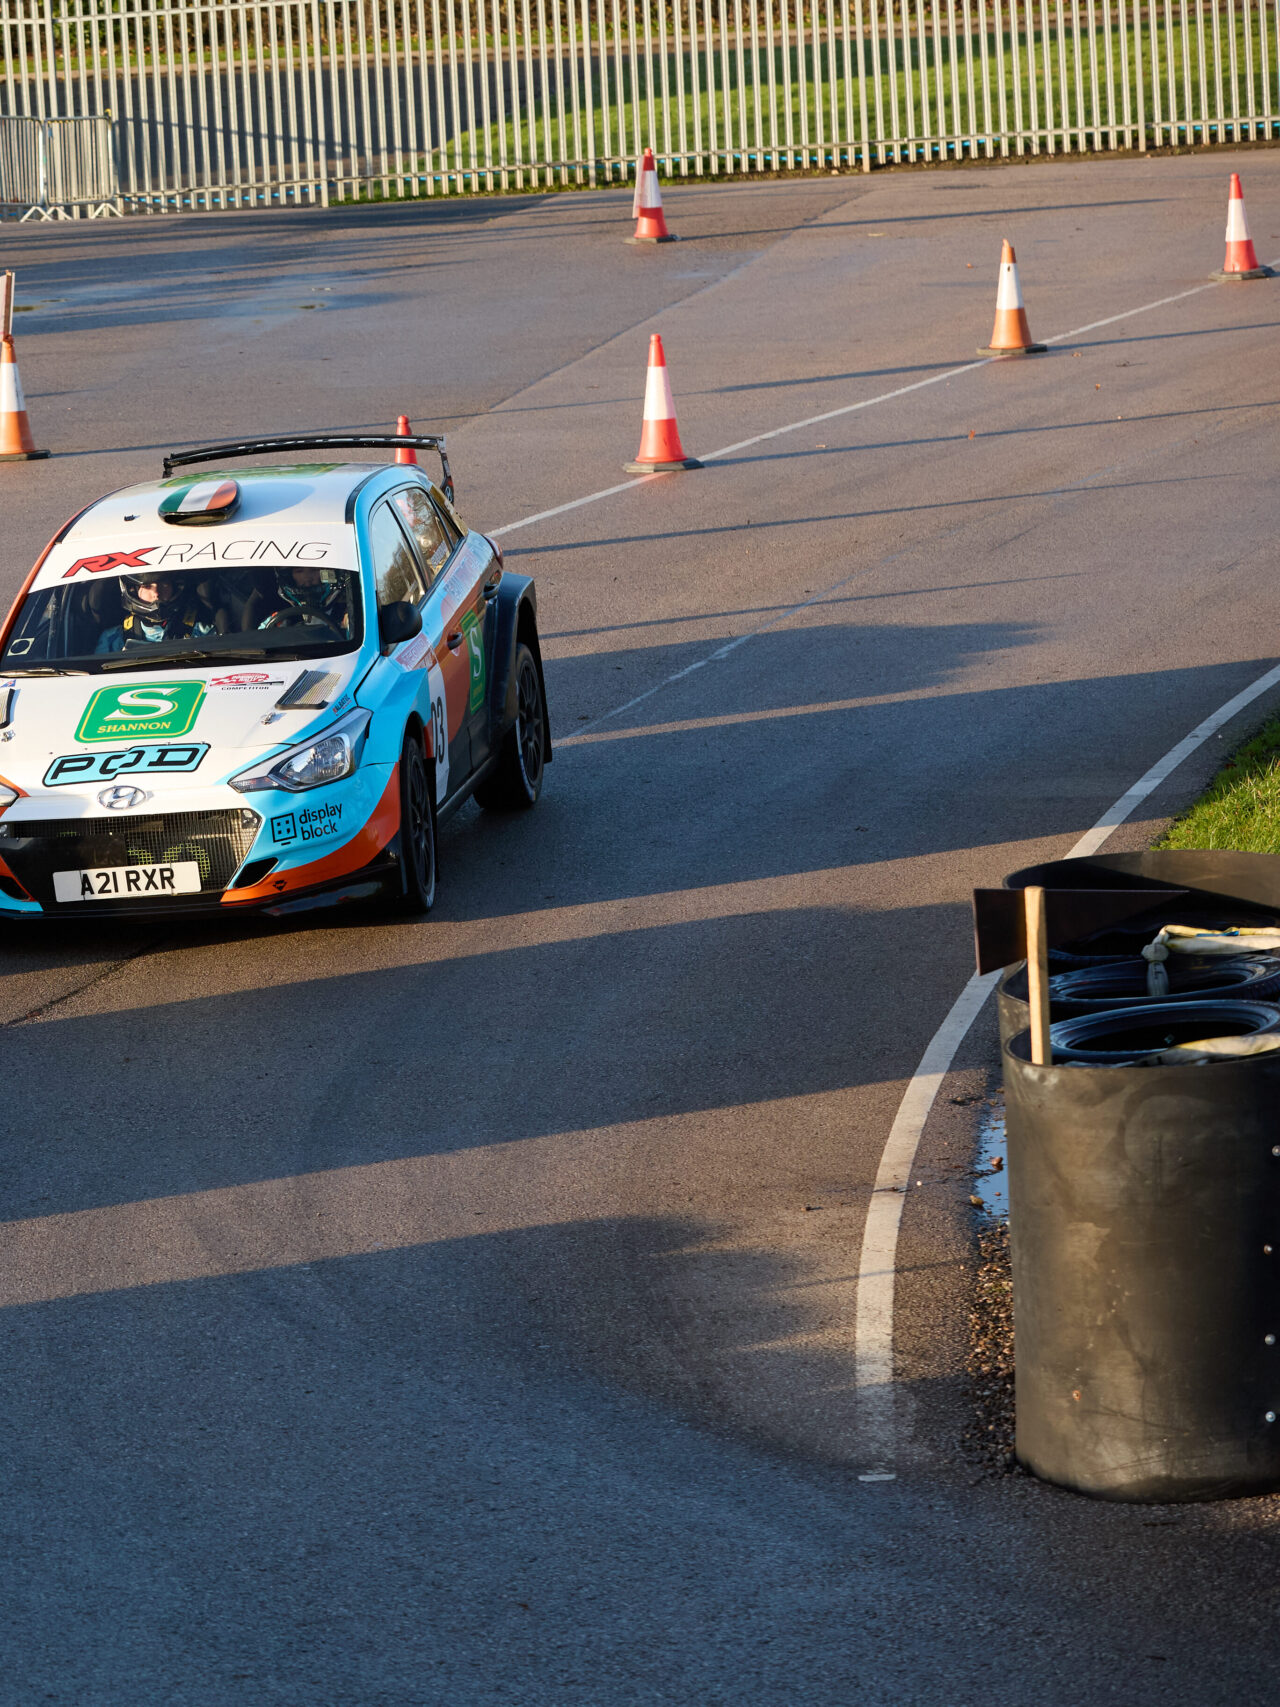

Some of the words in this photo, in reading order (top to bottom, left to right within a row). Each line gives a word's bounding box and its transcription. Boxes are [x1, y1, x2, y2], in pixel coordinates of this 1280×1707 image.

[62, 546, 162, 578] RX
[158, 540, 331, 564] RACING
[97, 721, 171, 734] SHANNON
[50, 748, 200, 779] POD
[299, 802, 342, 824] display
[301, 819, 338, 840] block
[80, 872, 119, 895] A21
[125, 868, 176, 892] RXR
